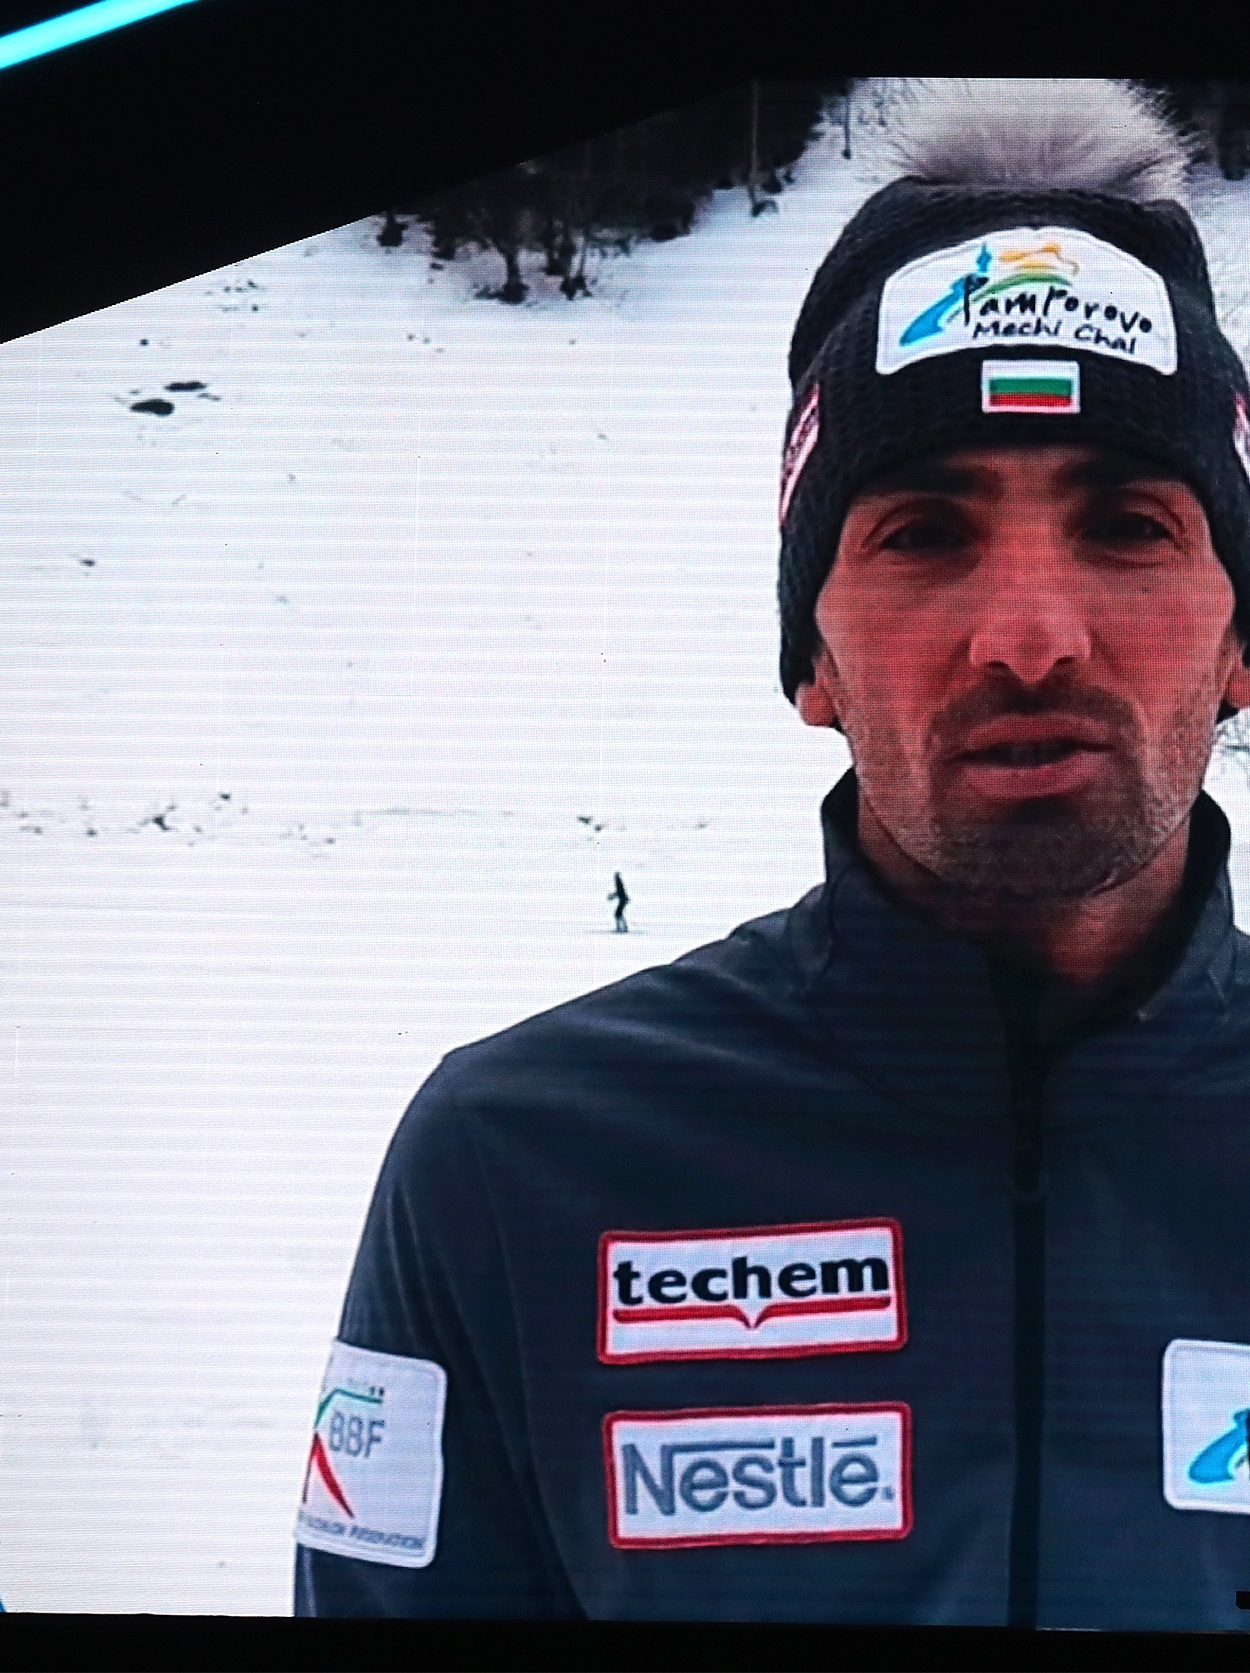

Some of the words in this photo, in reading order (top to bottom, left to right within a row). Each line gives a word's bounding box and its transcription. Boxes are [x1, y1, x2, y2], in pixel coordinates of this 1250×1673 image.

[973, 319, 1061, 340] Mechi
[1074, 323, 1136, 354] Chal
[613, 1256, 889, 1306] techem
[621, 1435, 880, 1516] Nestlé
